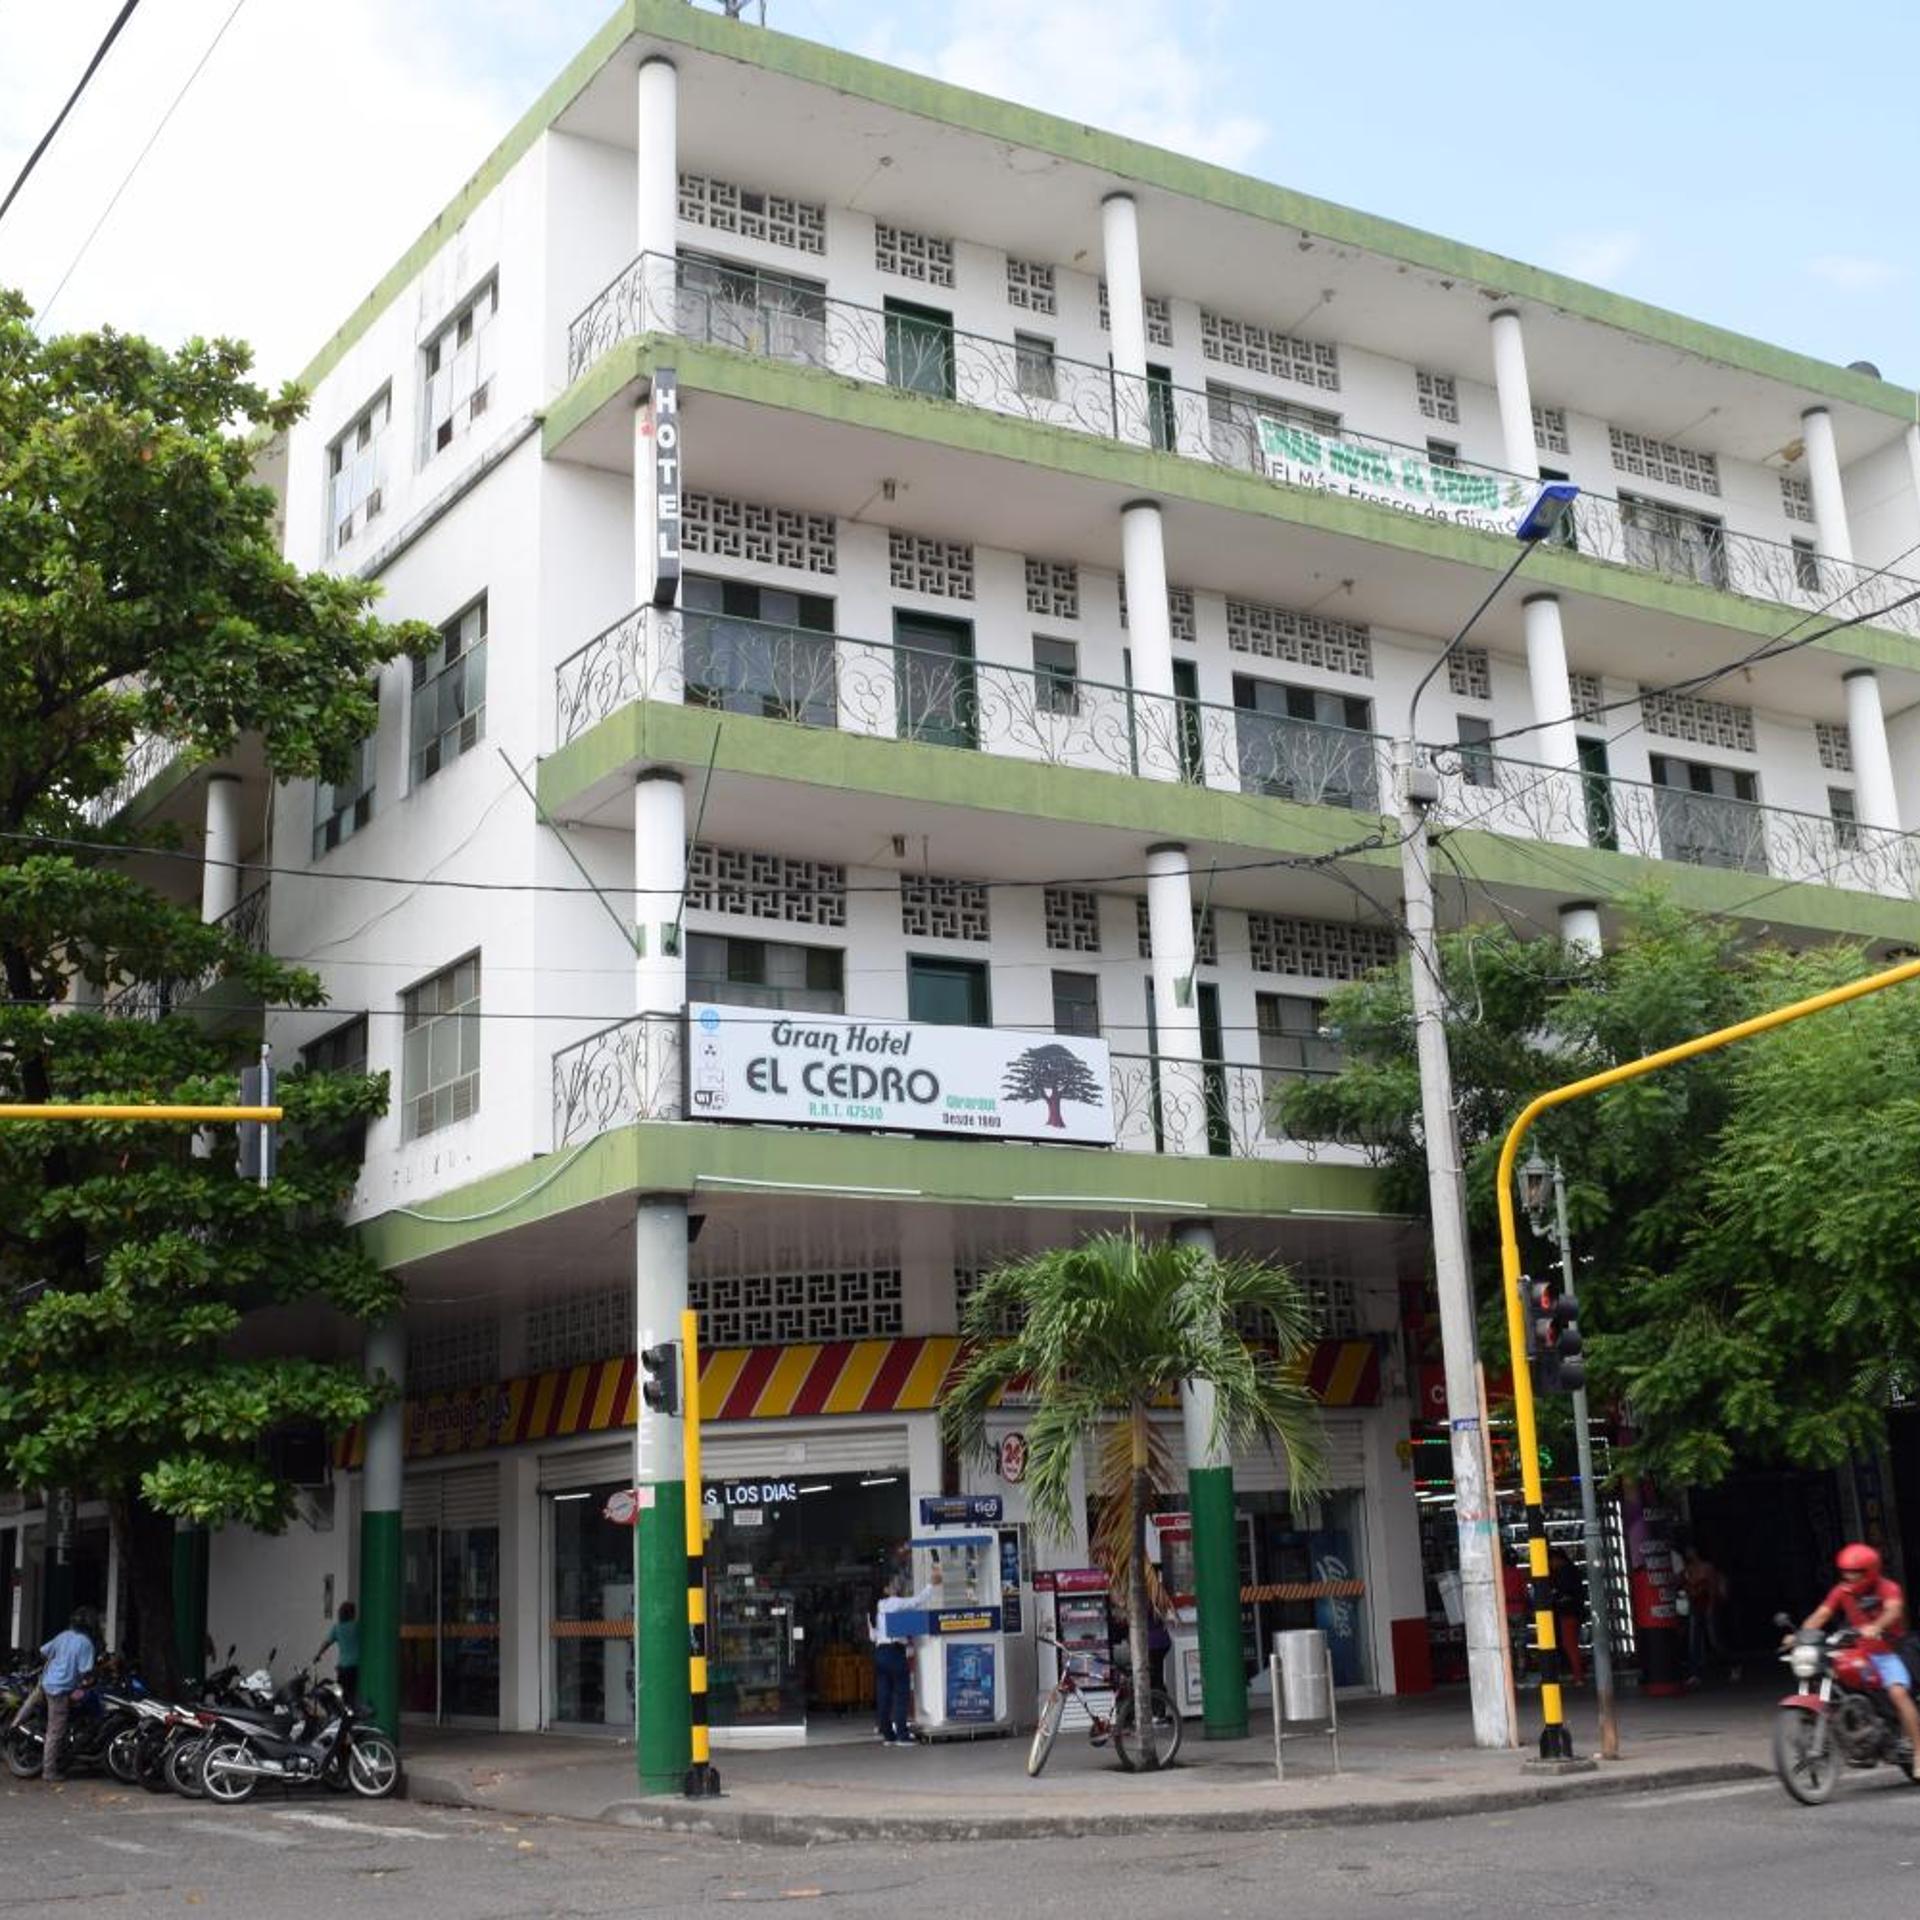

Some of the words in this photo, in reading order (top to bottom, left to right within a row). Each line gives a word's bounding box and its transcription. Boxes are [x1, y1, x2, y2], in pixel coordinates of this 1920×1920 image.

[655, 388, 679, 560] HOTEL
[771, 1020, 839, 1056] Gran
[846, 1025, 912, 1056] Hotel
[746, 1056, 788, 1094] EL
[802, 1061, 940, 1105] CEDRO
[725, 1485, 759, 1504] LOS
